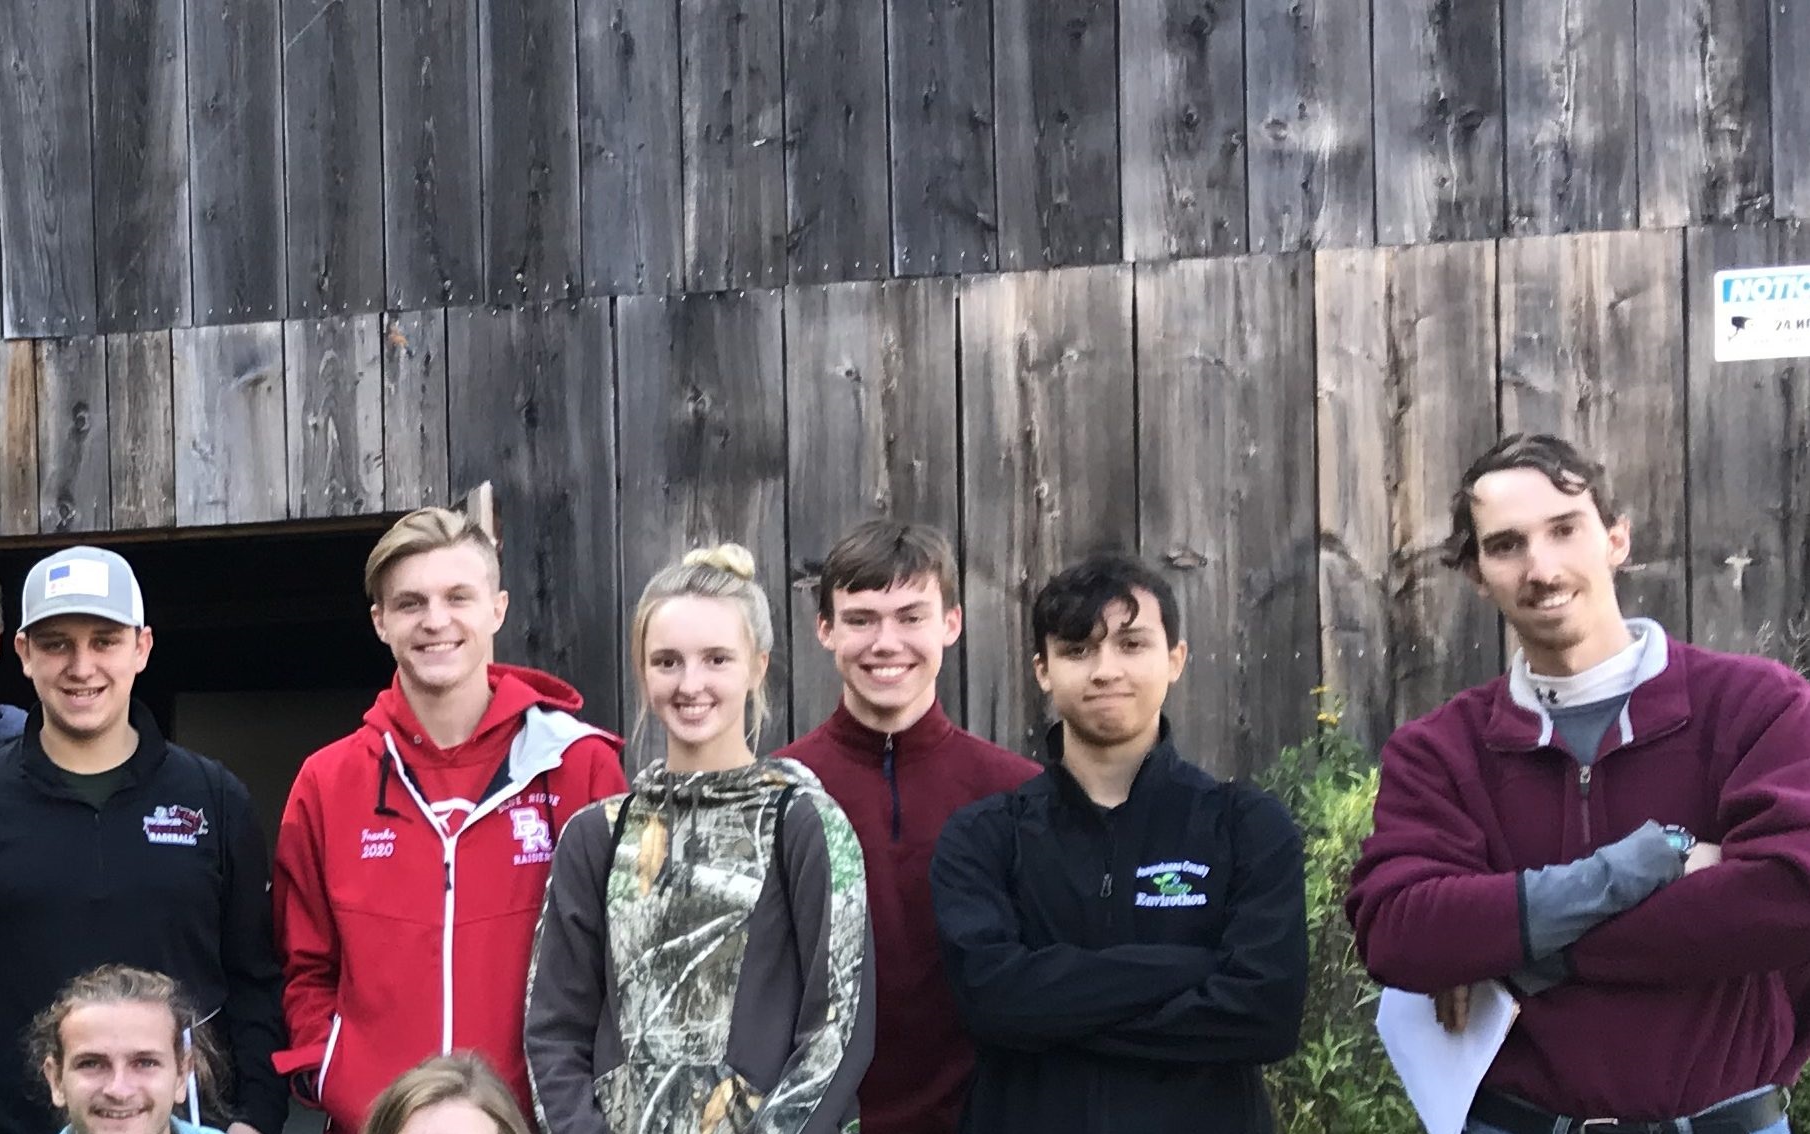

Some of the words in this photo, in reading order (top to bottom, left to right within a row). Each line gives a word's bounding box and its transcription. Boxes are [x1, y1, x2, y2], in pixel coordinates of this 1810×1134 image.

[149, 832, 197, 846] BASEBALL
[361, 842, 394, 859] 2020
[513, 851, 556, 866] RAIDER
[1135, 892, 1207, 907] Envirothon
